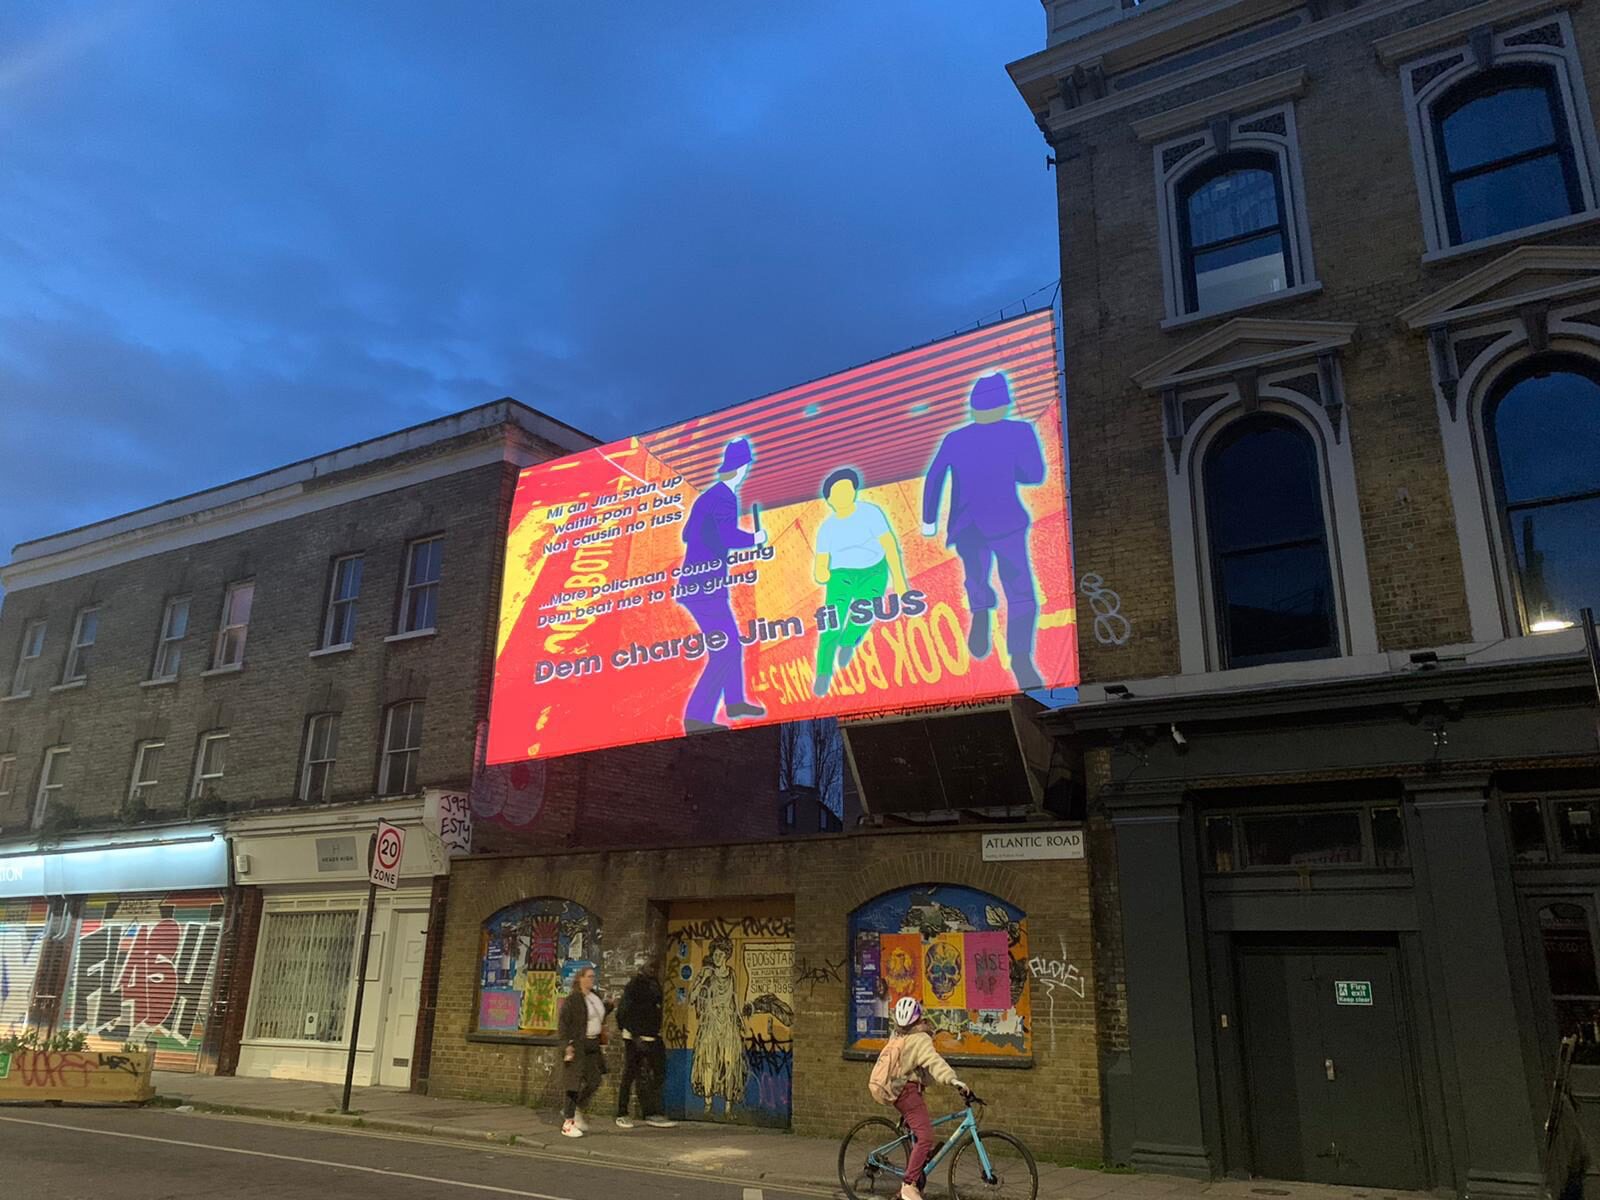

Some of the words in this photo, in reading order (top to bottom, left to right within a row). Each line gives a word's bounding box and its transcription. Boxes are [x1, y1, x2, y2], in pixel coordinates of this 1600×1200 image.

[546, 507, 563, 520] Mi
[567, 500, 587, 515] an
[591, 493, 619, 510] Jim
[622, 482, 657, 501] stan
[661, 475, 683, 491] up
[553, 514, 599, 535] waitin
[601, 505, 633, 524] pon
[637, 501, 649, 513] a
[653, 491, 682, 510] bus
[542, 539, 569, 555] Not
[572, 526, 621, 548] causin
[625, 518, 646, 534] no
[650, 508, 683, 527] fuss
[591, 570, 666, 598] policman
[672, 557, 722, 579] come
[726, 543, 774, 567] dung
[537, 611, 571, 628] Dem
[575, 600, 614, 620] beat
[617, 593, 643, 610] me
[648, 588, 664, 602] to
[669, 579, 700, 598] the
[702, 567, 758, 596] grung
[534, 655, 602, 684] Dem
[611, 628, 729, 671] charge
[739, 615, 803, 646] Jim
[816, 603, 839, 632] fi
[849, 589, 928, 625] sus
[381, 838, 398, 858] 20
[985, 836, 1042, 849] ATLANTIC
[1046, 835, 1080, 847] ROAD
[373, 868, 396, 885] ZONE
[751, 951, 794, 967] DOGSTAR
[750, 983, 771, 994] SINCE
